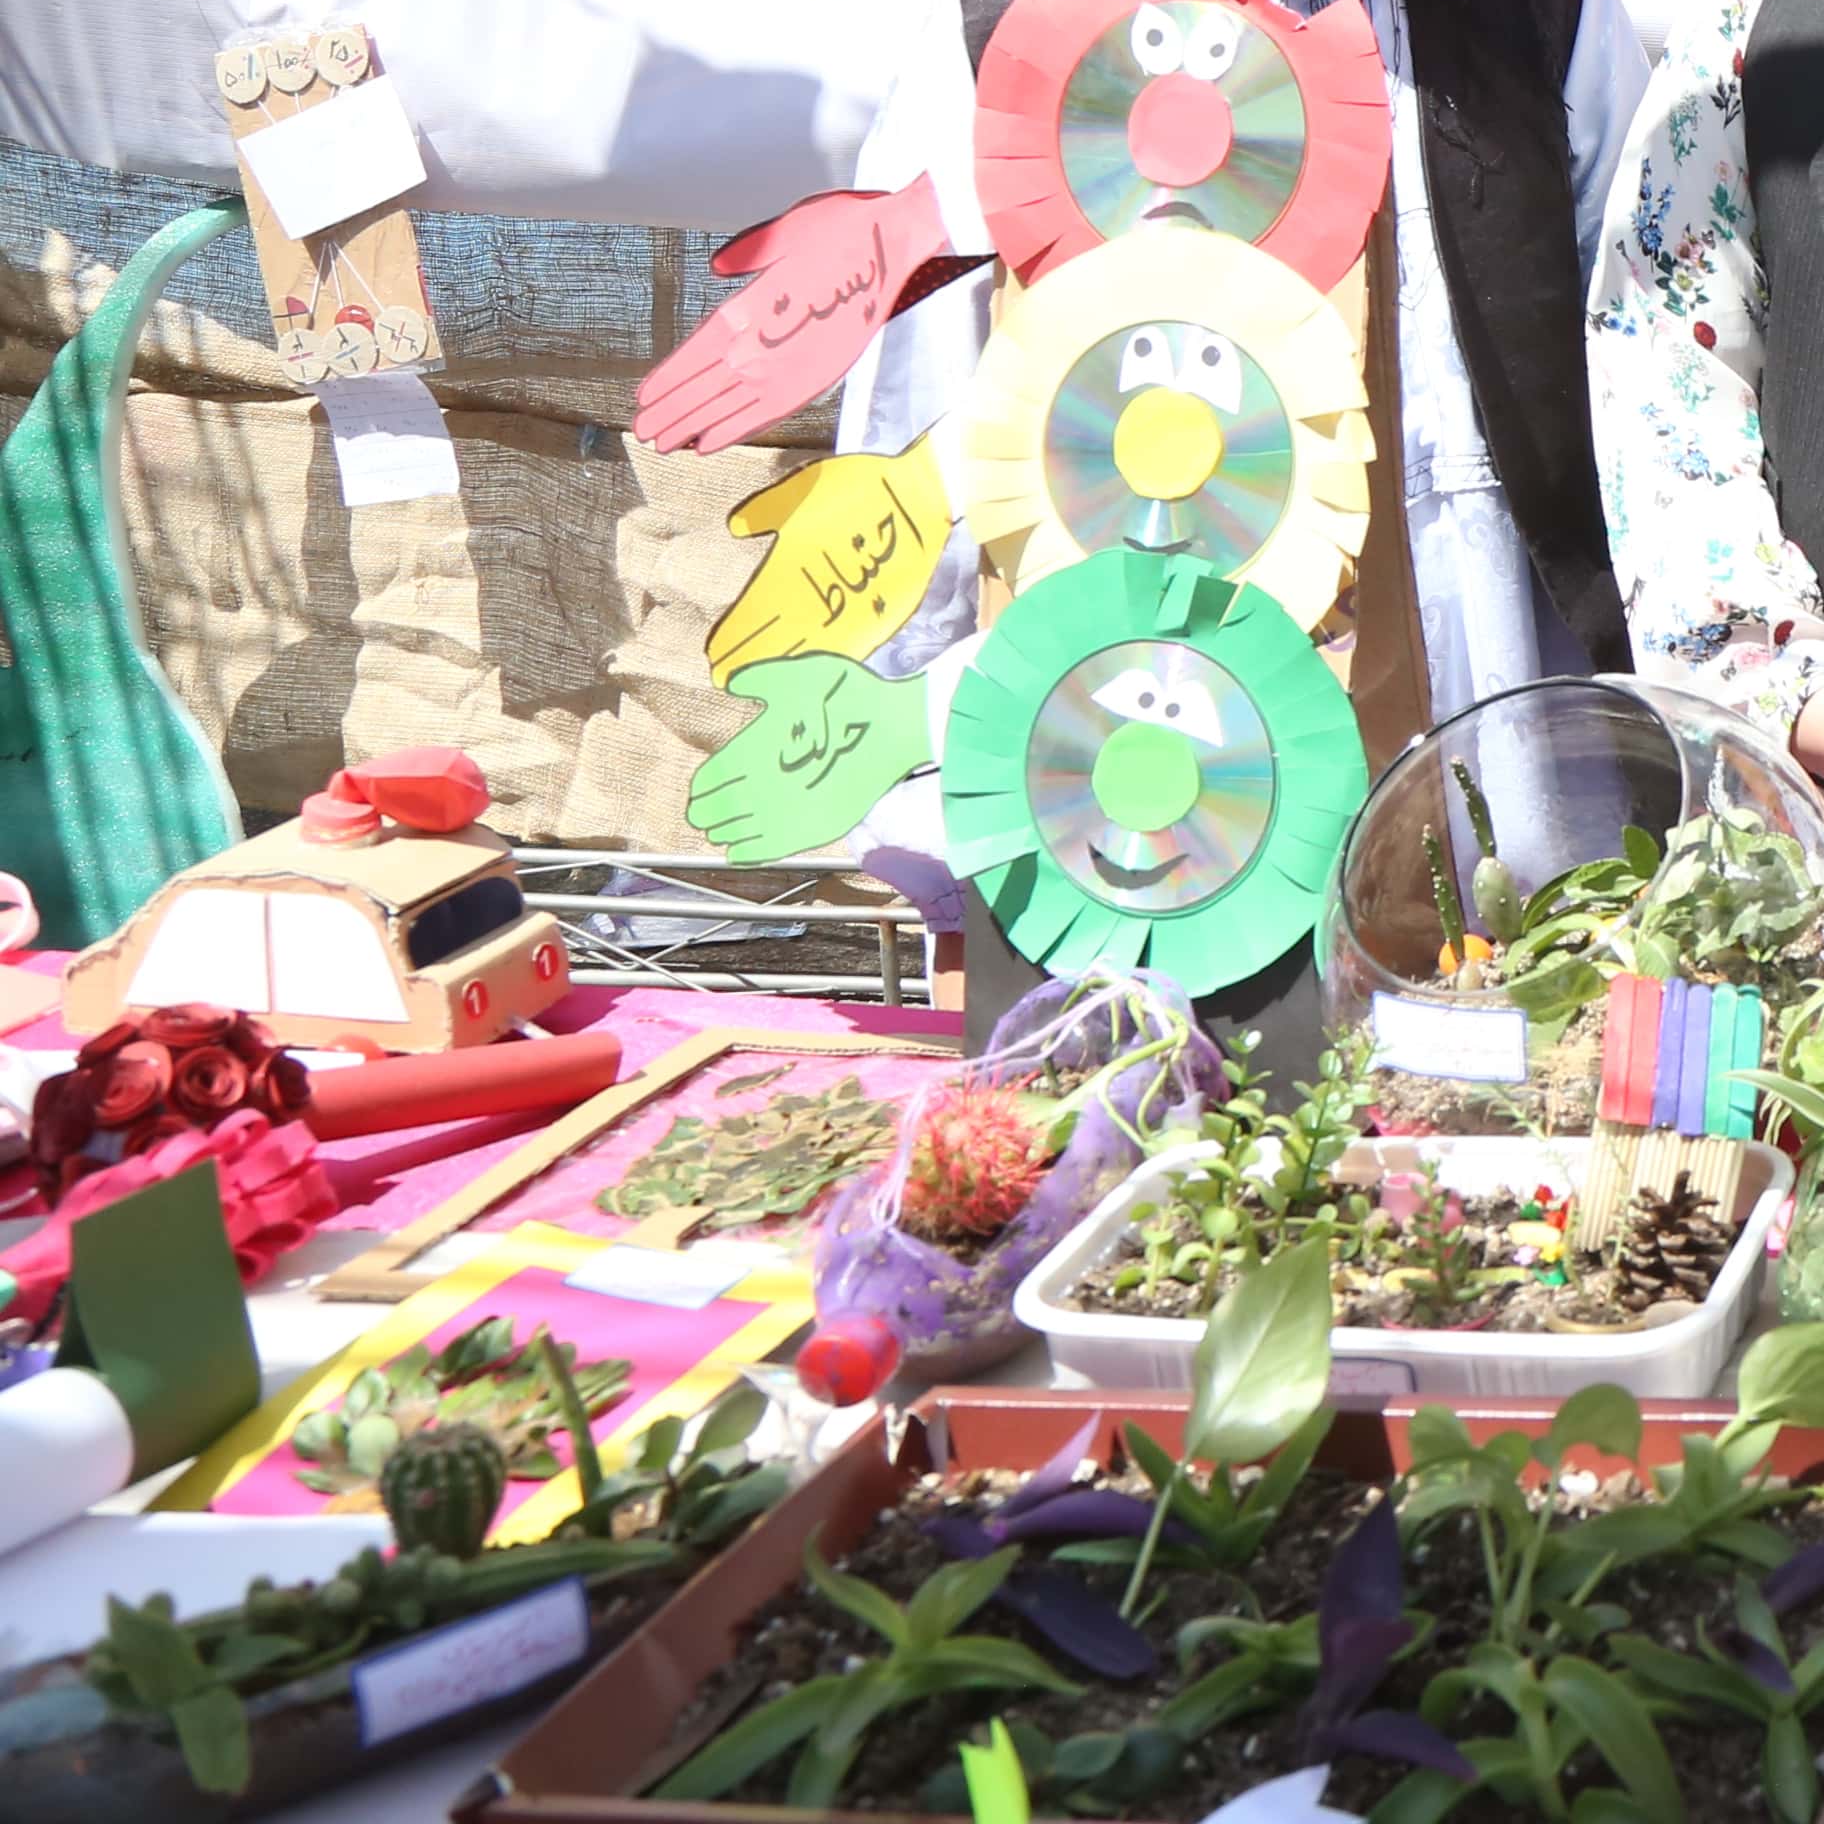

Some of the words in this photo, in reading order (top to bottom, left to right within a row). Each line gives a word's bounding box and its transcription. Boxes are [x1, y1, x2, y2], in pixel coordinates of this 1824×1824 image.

[759, 222, 889, 346] ایست
[799, 476, 925, 628] احتیاط
[777, 666, 870, 791] حرکت
